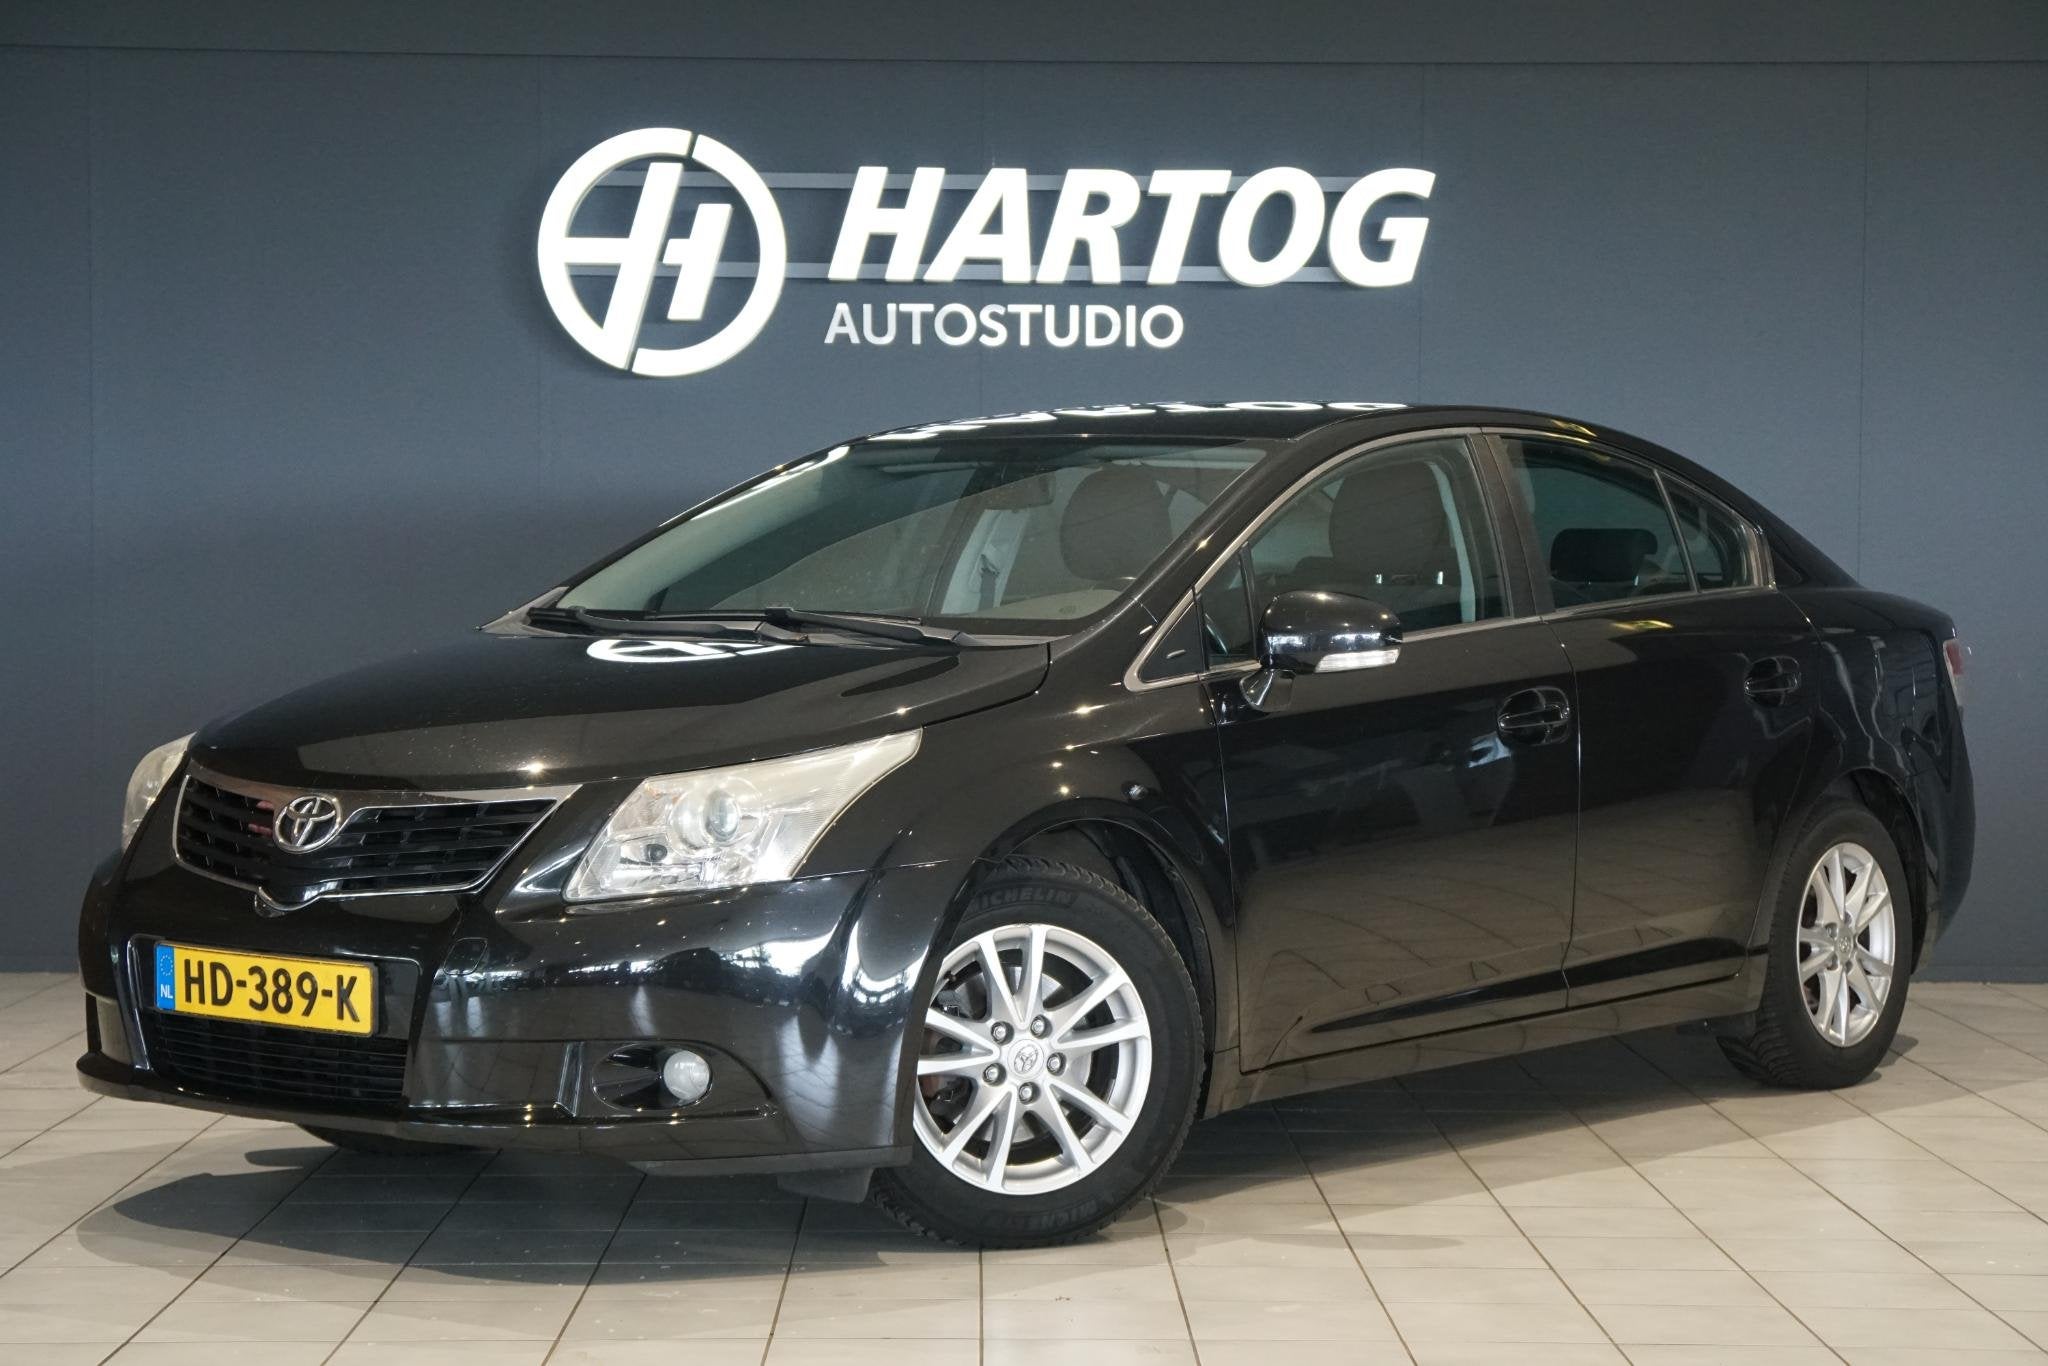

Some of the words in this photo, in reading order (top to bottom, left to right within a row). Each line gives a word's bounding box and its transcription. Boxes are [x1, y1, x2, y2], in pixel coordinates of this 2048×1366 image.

[828, 167, 1436, 287] HARTOG
[825, 302, 1184, 349] AUTOSTUDIO
[160, 984, 174, 999] NL
[184, 959, 360, 1022] HD-389-K
